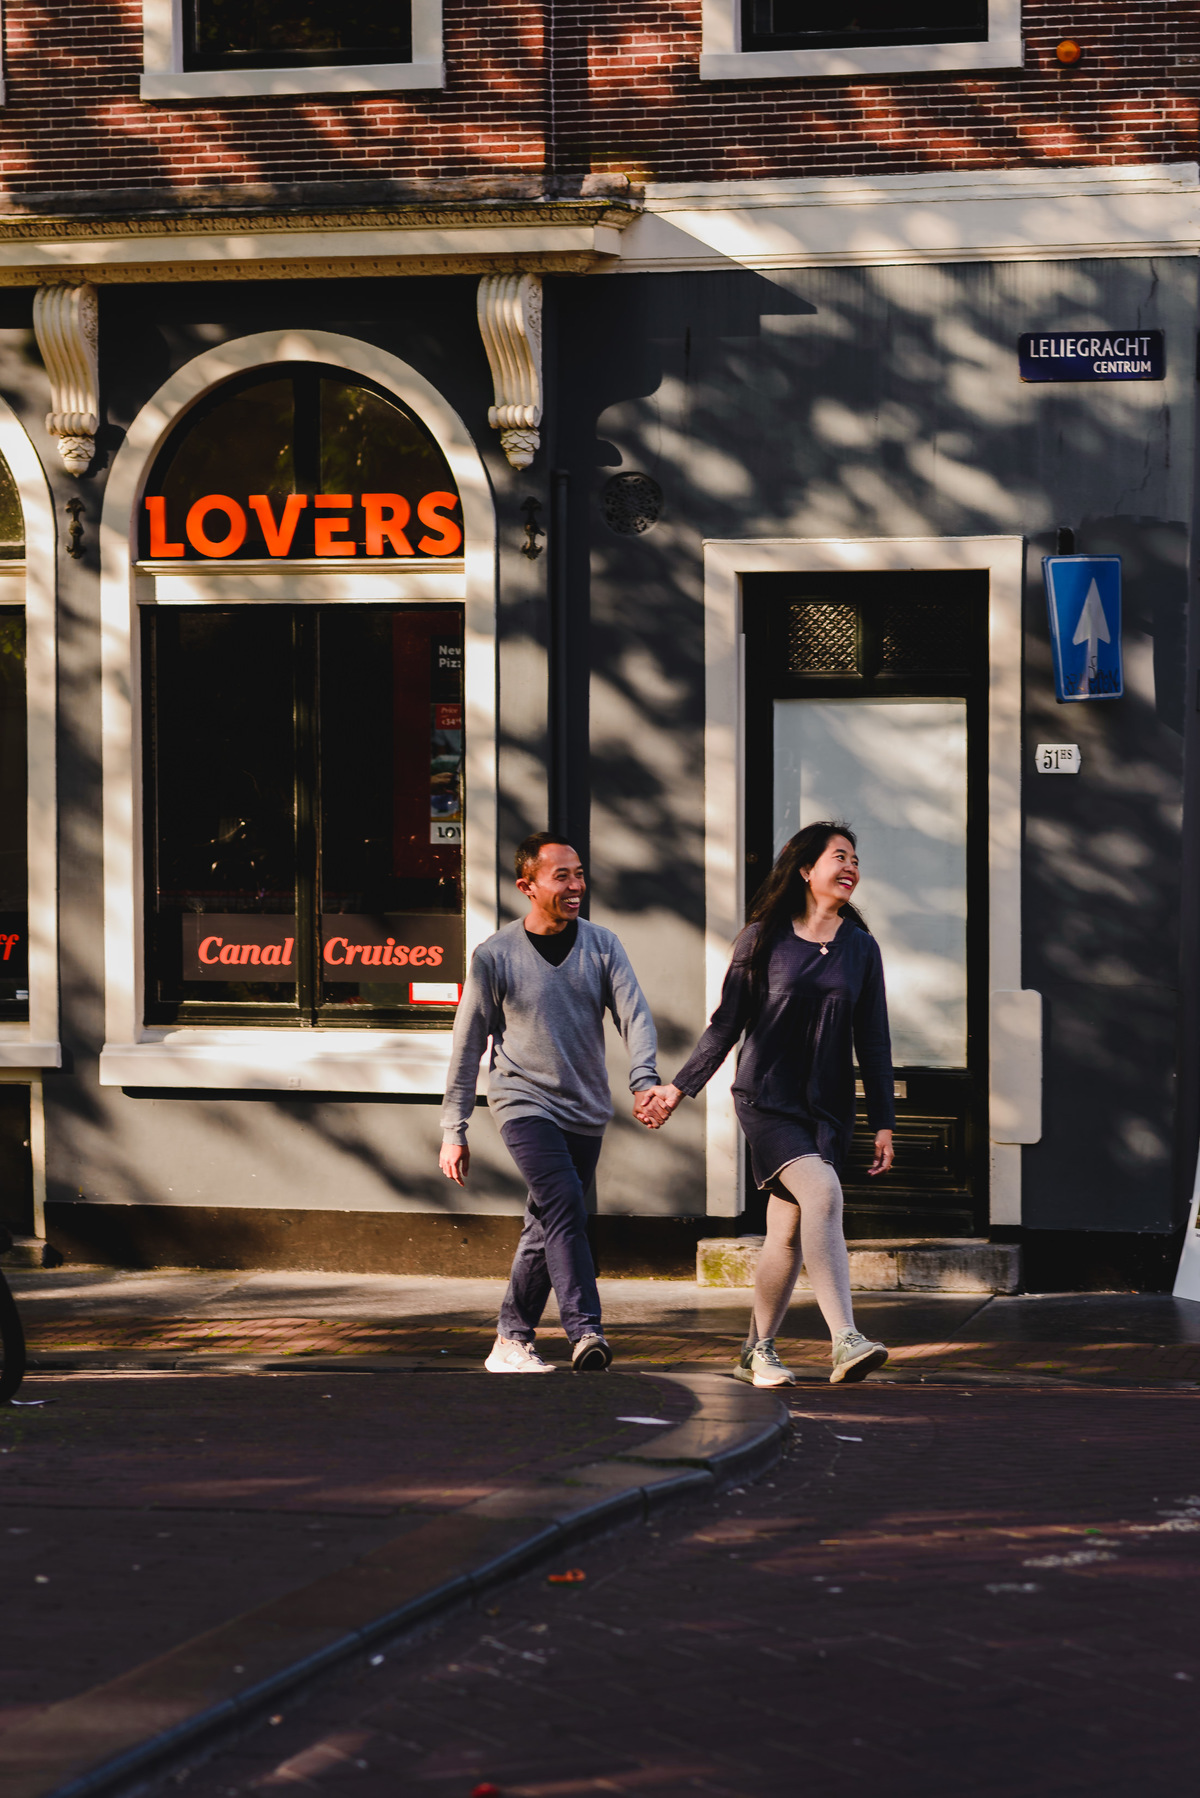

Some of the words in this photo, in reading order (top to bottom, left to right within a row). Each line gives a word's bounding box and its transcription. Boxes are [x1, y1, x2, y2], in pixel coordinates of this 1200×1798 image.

[1030, 337, 1151, 358] LELIEGRACHT
[1093, 360, 1152, 373] CENTRUM
[145, 491, 462, 557] LOVERS
[198, 936, 295, 966] Canal
[323, 937, 445, 967] Cruises
